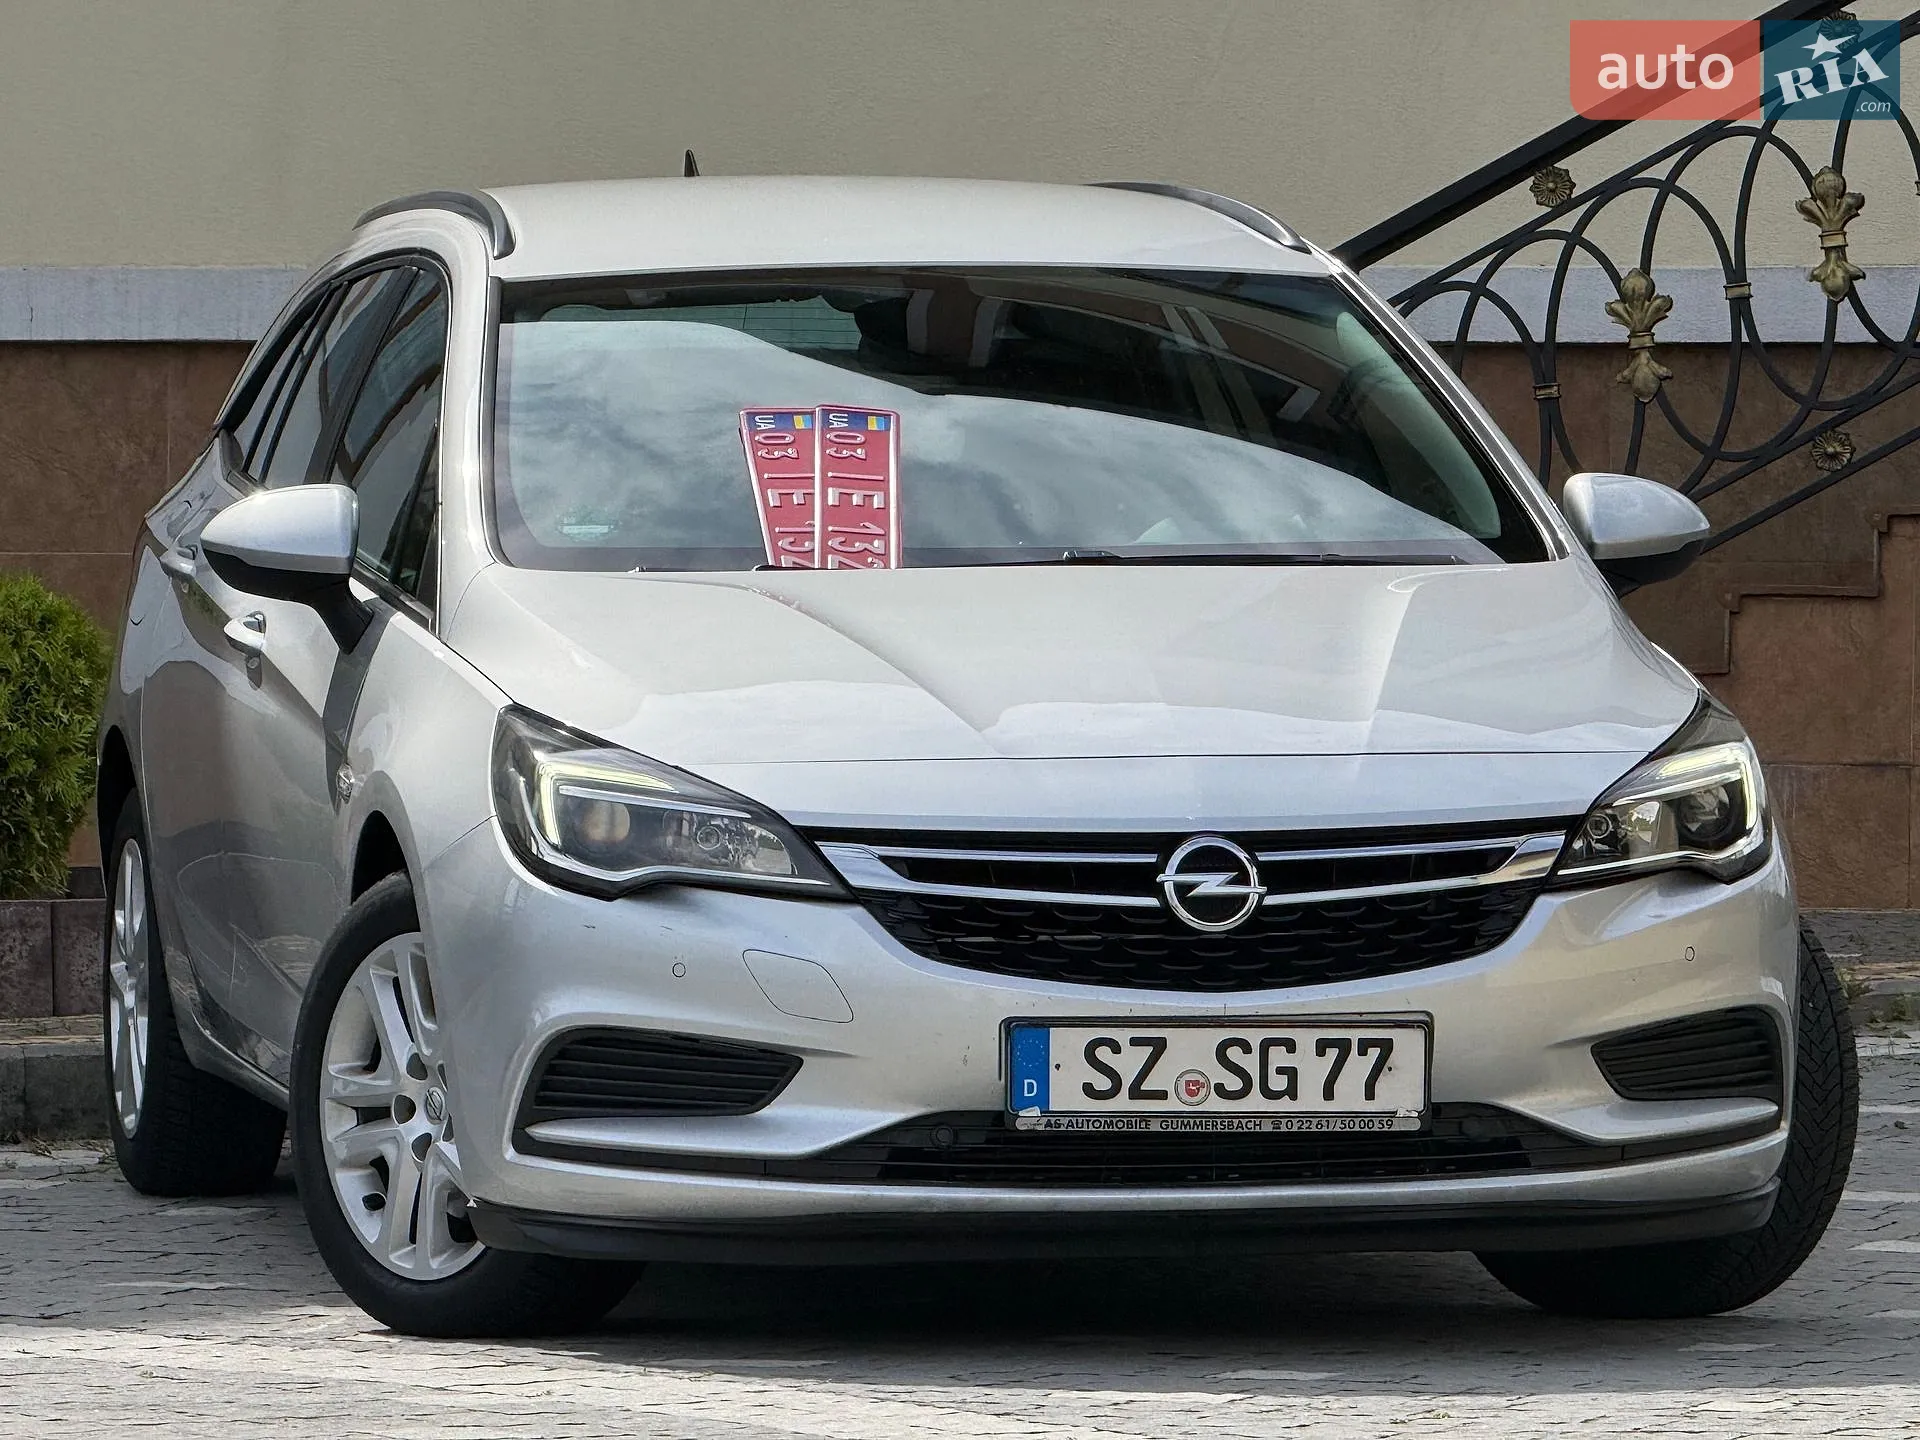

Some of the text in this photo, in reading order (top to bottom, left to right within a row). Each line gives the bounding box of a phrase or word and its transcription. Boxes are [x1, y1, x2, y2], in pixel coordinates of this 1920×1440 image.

[754, 415, 776, 431] UA
[828, 413, 849, 429] UA
[755, 432, 800, 459] 03
[826, 431, 867, 461] 03
[827, 471, 885, 510] IE
[1082, 1036, 1395, 1102] SZ SG 77
[1023, 1079, 1038, 1097] D
[1159, 1119, 1263, 1131] GUMMERSBACH
